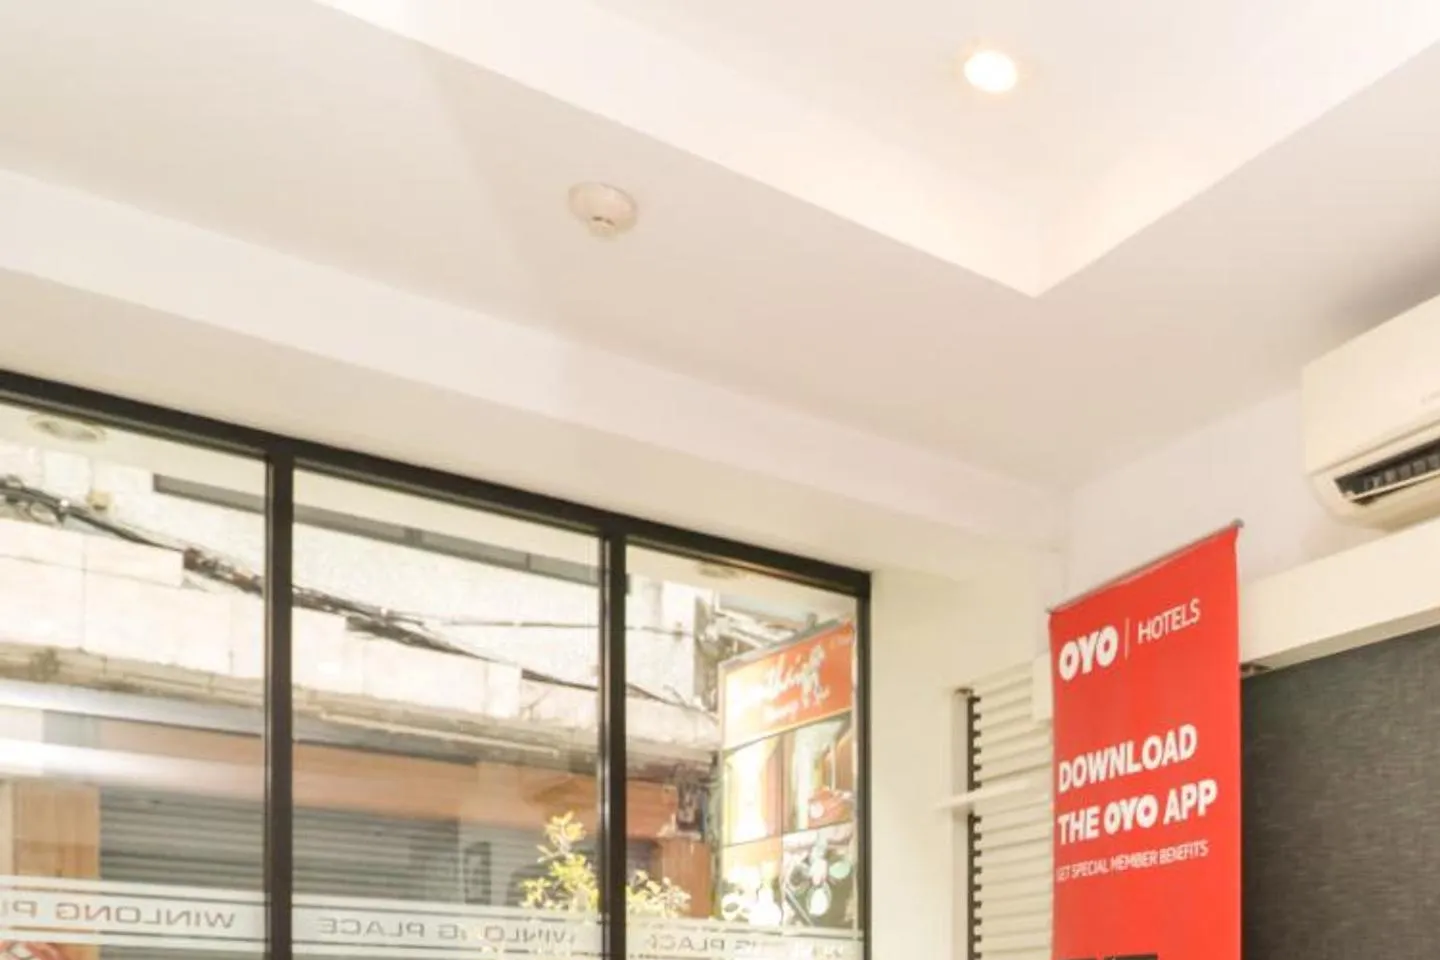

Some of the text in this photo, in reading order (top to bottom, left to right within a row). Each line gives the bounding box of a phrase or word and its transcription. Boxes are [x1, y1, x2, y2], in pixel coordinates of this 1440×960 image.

[1058, 597, 1201, 682] OYO HOTELS
[1058, 723, 1198, 794] DOWNLOAD
[1057, 779, 1218, 845] THE OYO APP
[1071, 858, 1109, 879] SPECIAL
[1110, 849, 1158, 874] MEMBER
[1159, 838, 1209, 865] BENEFITS
